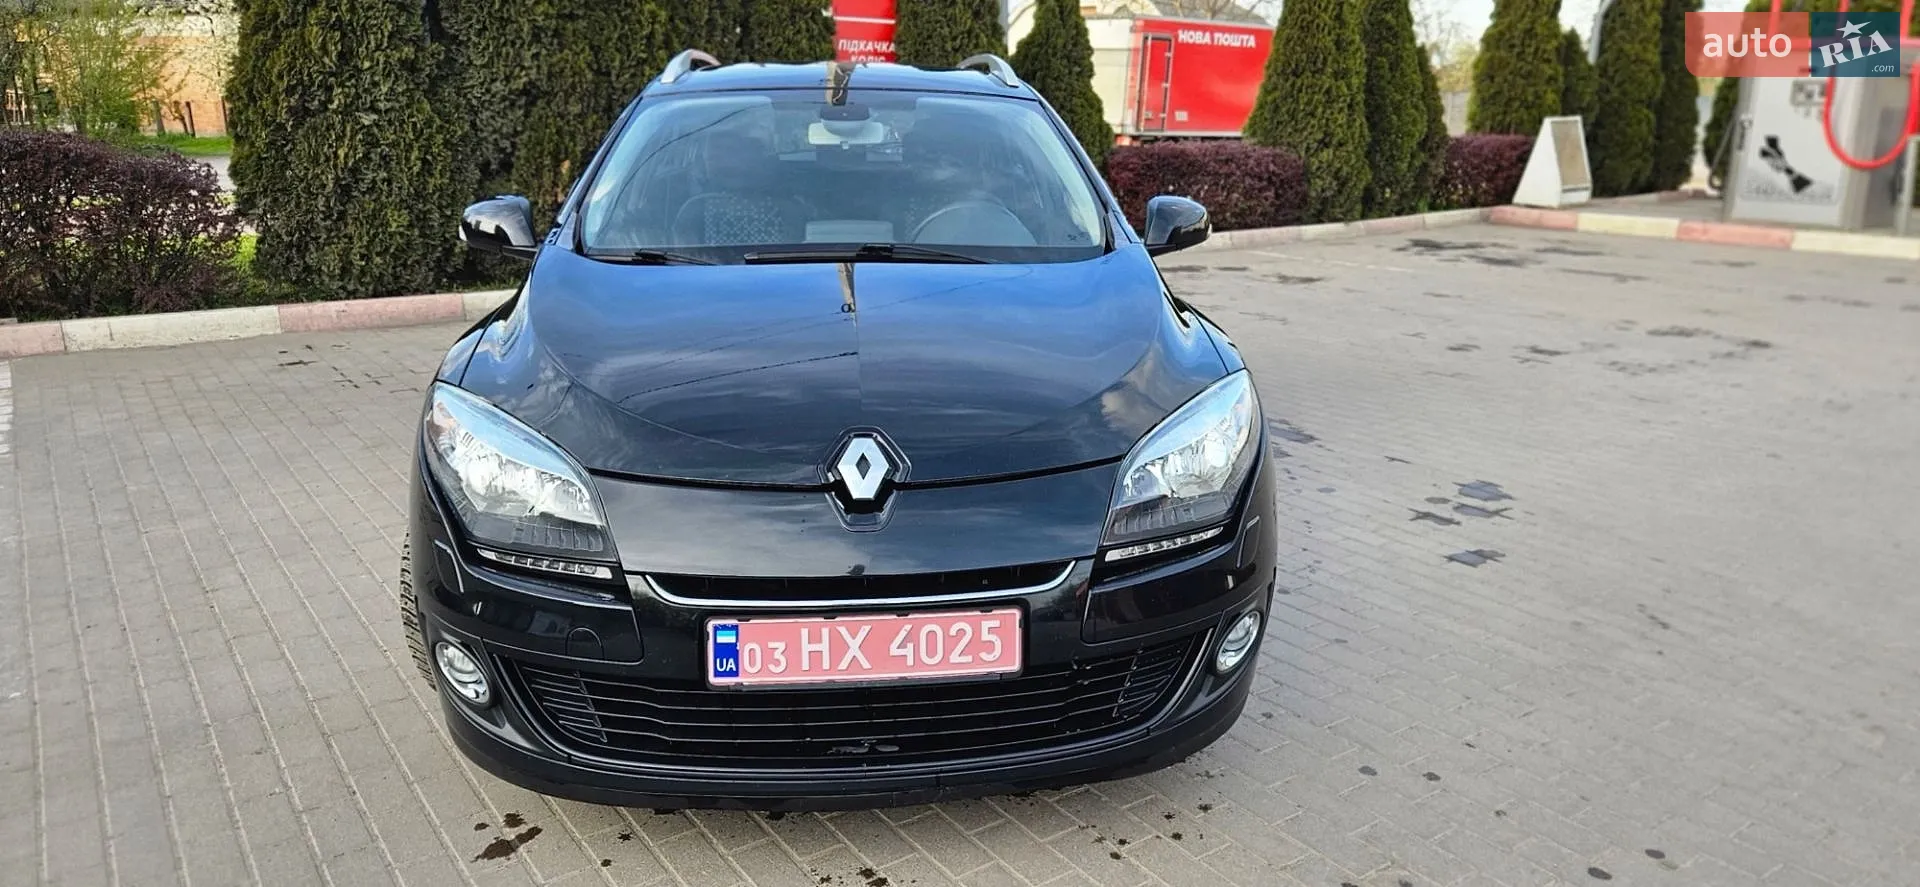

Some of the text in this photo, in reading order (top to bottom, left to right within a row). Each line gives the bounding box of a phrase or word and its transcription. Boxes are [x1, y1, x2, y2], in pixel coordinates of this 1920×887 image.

[838, 39, 895, 53] ПІДКАЧКА
[1178, 29, 1256, 48] НОВА ПОШТА
[743, 619, 1002, 674] 03 HX 4025
[716, 658, 736, 672] UA
